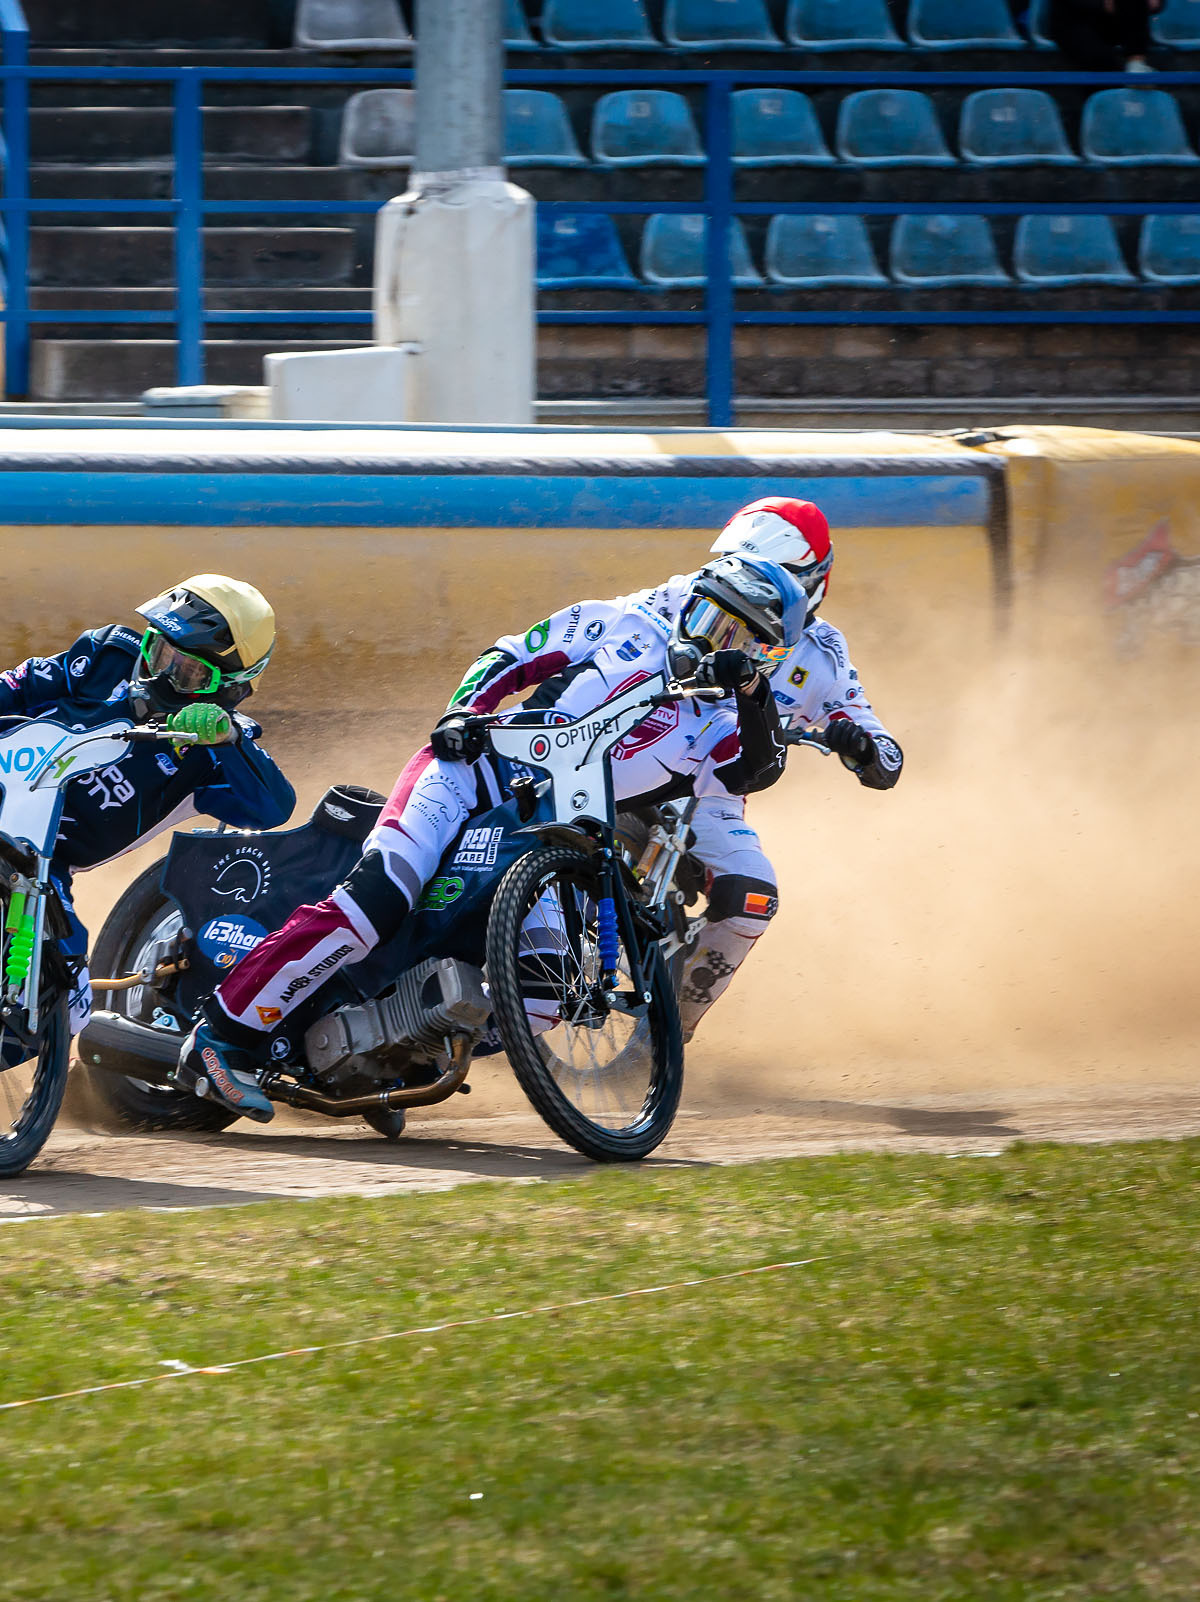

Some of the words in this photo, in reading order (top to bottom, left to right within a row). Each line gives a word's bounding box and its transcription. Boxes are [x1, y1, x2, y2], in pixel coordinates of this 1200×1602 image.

[563, 605, 581, 644] OPTIBET
[555, 716, 621, 749] OPTIBET
[235, 846, 264, 860] BEACH
[201, 1047, 245, 1104] daytona
